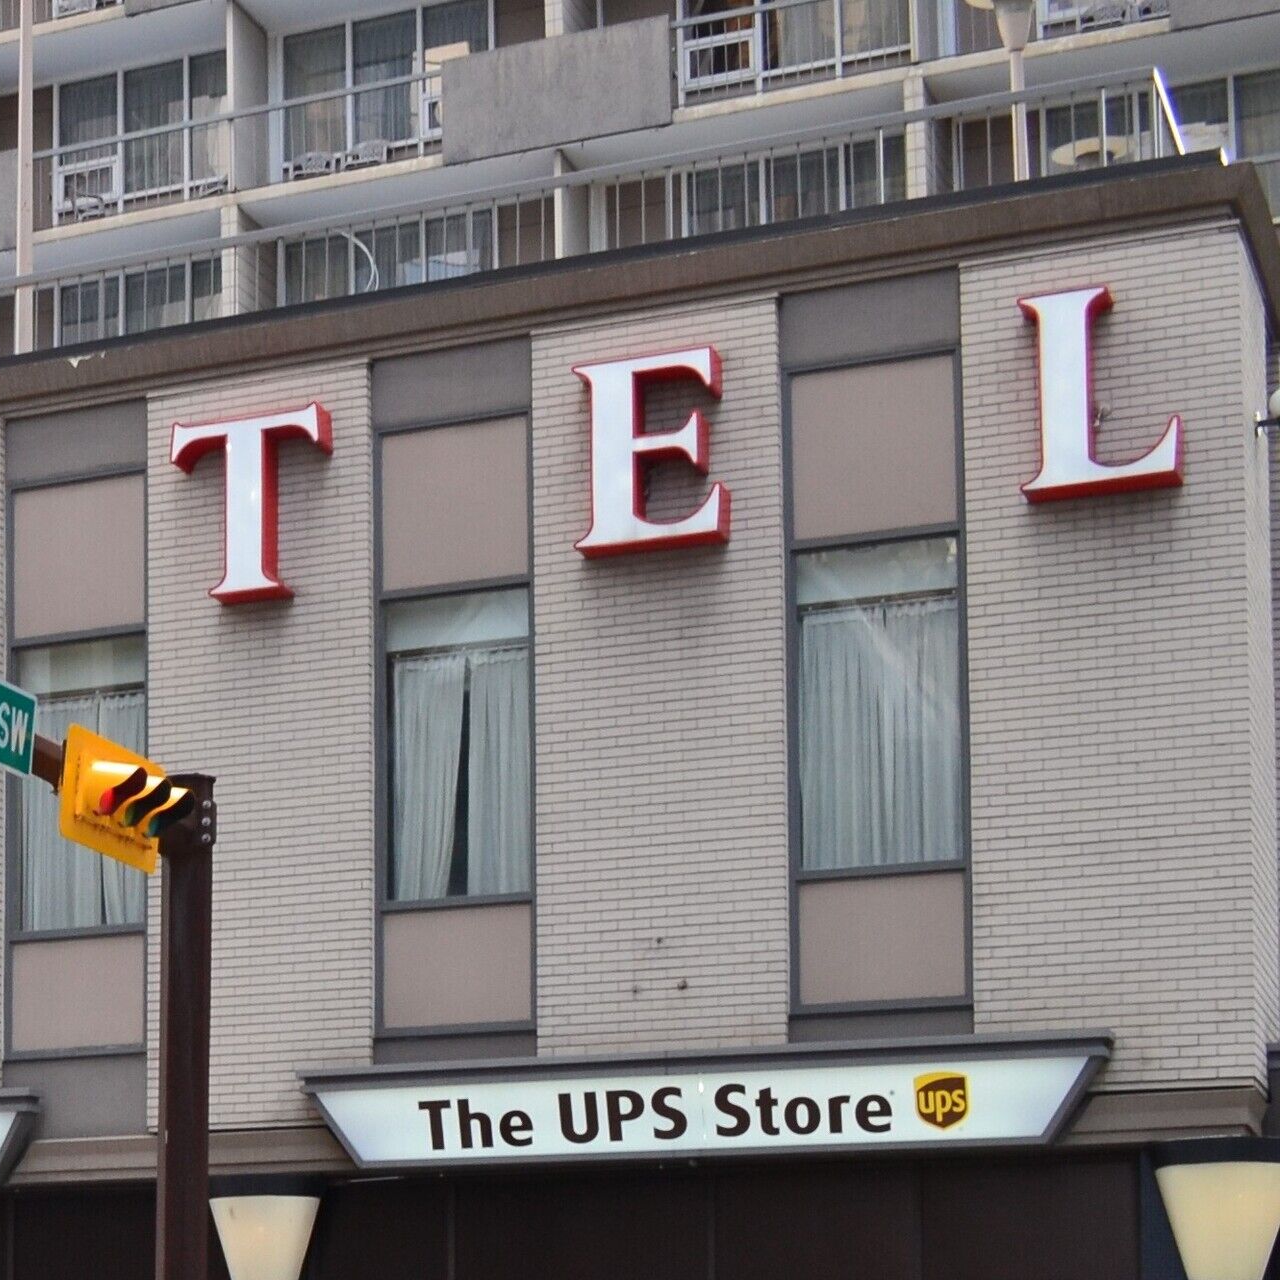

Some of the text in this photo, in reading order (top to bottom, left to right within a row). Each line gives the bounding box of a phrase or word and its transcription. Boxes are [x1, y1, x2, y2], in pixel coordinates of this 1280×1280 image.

[417, 1083, 895, 1151] The UPS Store
[917, 1085, 967, 1126] ups
